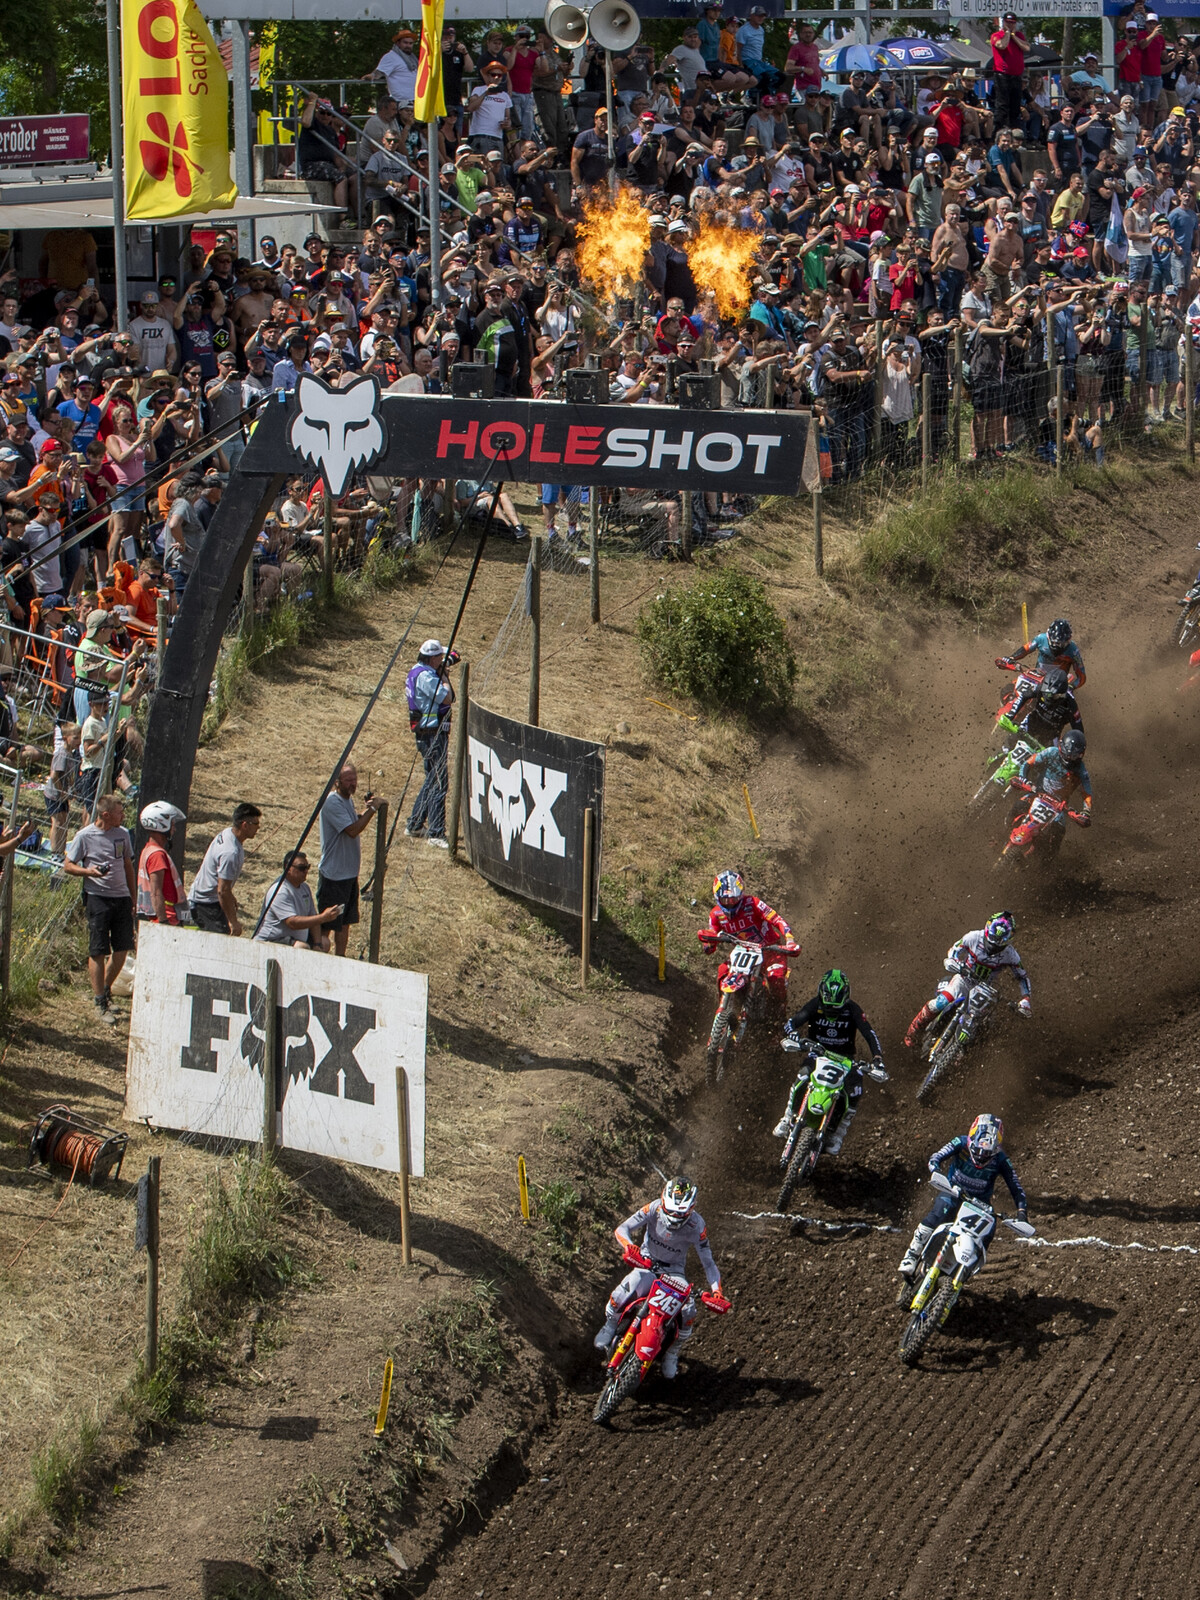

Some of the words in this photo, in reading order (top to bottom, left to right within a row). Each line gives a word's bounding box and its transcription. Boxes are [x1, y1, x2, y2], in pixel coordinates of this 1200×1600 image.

[141, 327, 164, 339] FOX
[436, 419, 782, 475] HOLESHOT
[732, 952, 760, 969] 101
[815, 1018, 849, 1028] JUST1
[817, 1065, 844, 1085] 3
[960, 1213, 992, 1235] 41
[647, 1235, 682, 1254] HONDA
[649, 1289, 683, 1316] 243
